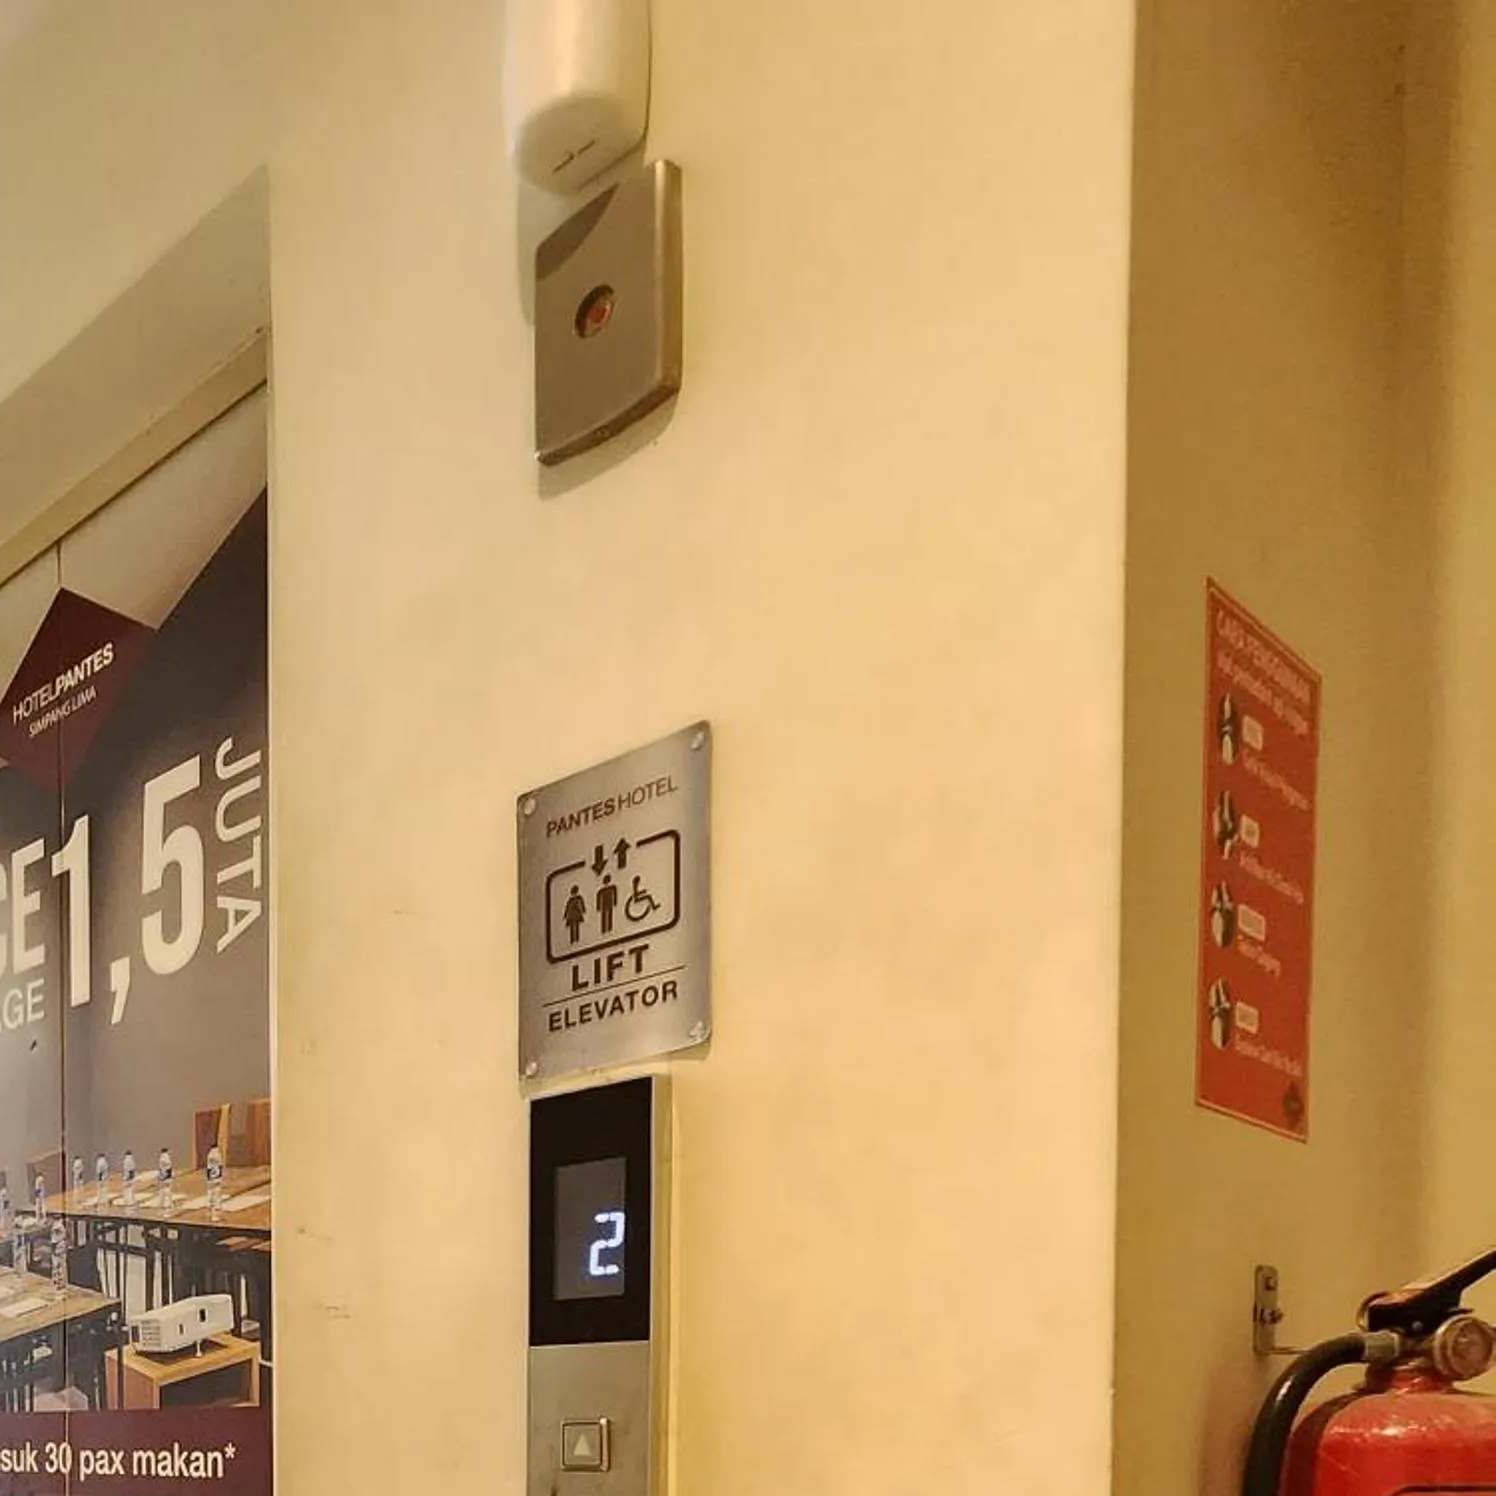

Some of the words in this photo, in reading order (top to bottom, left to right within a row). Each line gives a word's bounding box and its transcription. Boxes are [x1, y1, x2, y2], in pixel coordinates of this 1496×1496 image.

[214, 736, 262, 954] JUTA
[572, 944, 650, 992] LIFT
[548, 980, 678, 1033] ELEVATOR
[589, 1211, 625, 1276] 2
[44, 1442, 72, 1475] 30
[79, 1449, 125, 1481] pax
